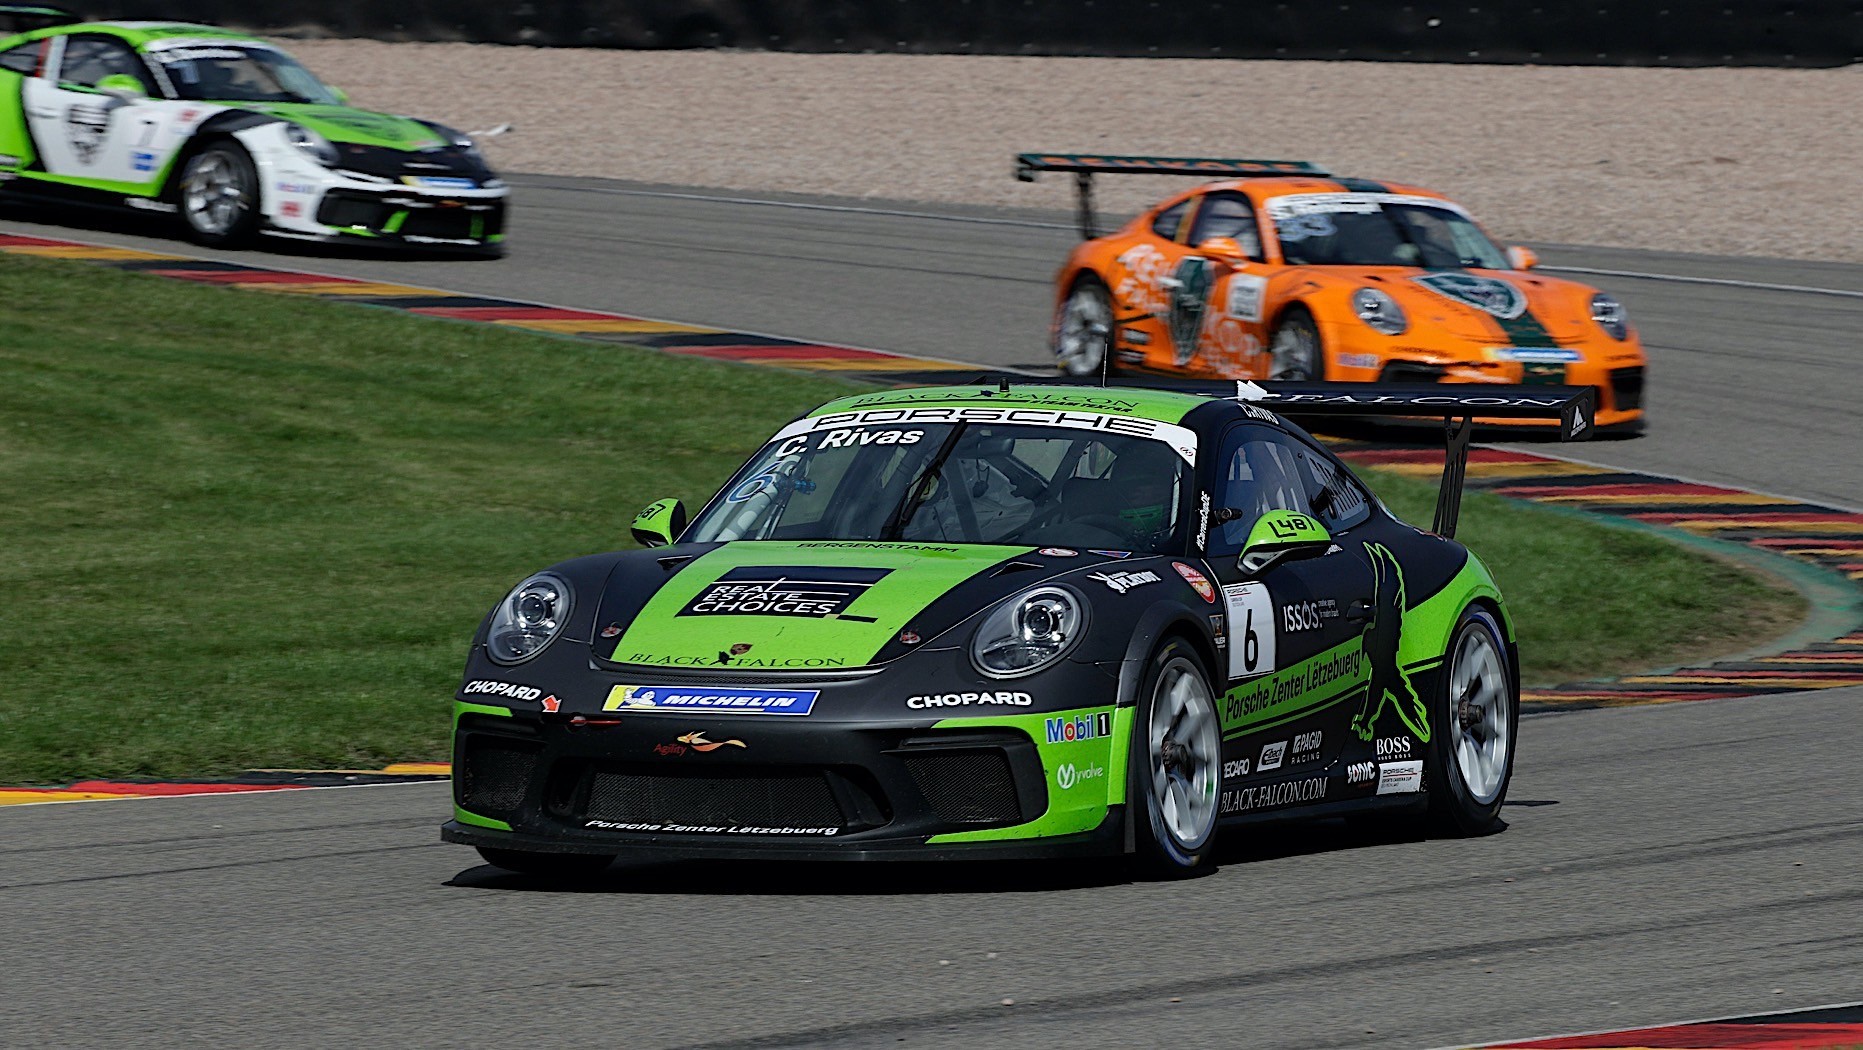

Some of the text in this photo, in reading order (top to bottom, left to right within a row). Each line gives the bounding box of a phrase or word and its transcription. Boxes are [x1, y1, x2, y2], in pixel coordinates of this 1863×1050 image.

[1284, 394, 1568, 406] FALCON
[812, 409, 1157, 436] PORSCHE
[775, 426, 926, 458] C. Rivas
[797, 542, 959, 553] BERGENSTAMM
[702, 592, 803, 601] ESTATE
[692, 601, 836, 614] CHOICES
[1244, 608, 1259, 673] 6
[629, 653, 846, 667] BLACK FALCON
[463, 680, 543, 701] CHOPARD
[1225, 650, 1361, 723] Porsche Zenter Lëtzebuerg
[662, 693, 798, 708] MICHELIN
[906, 692, 1032, 709] CHOPARD
[1044, 714, 1094, 745] Mobil
[1300, 730, 1322, 752] PAGID
[1376, 736, 1411, 756] BOSS
[1291, 751, 1321, 765] RACING
[1221, 777, 1328, 813] BLACK-FALCON.COM
[585, 819, 661, 831] Porsche
[662, 823, 727, 833] Zenter
